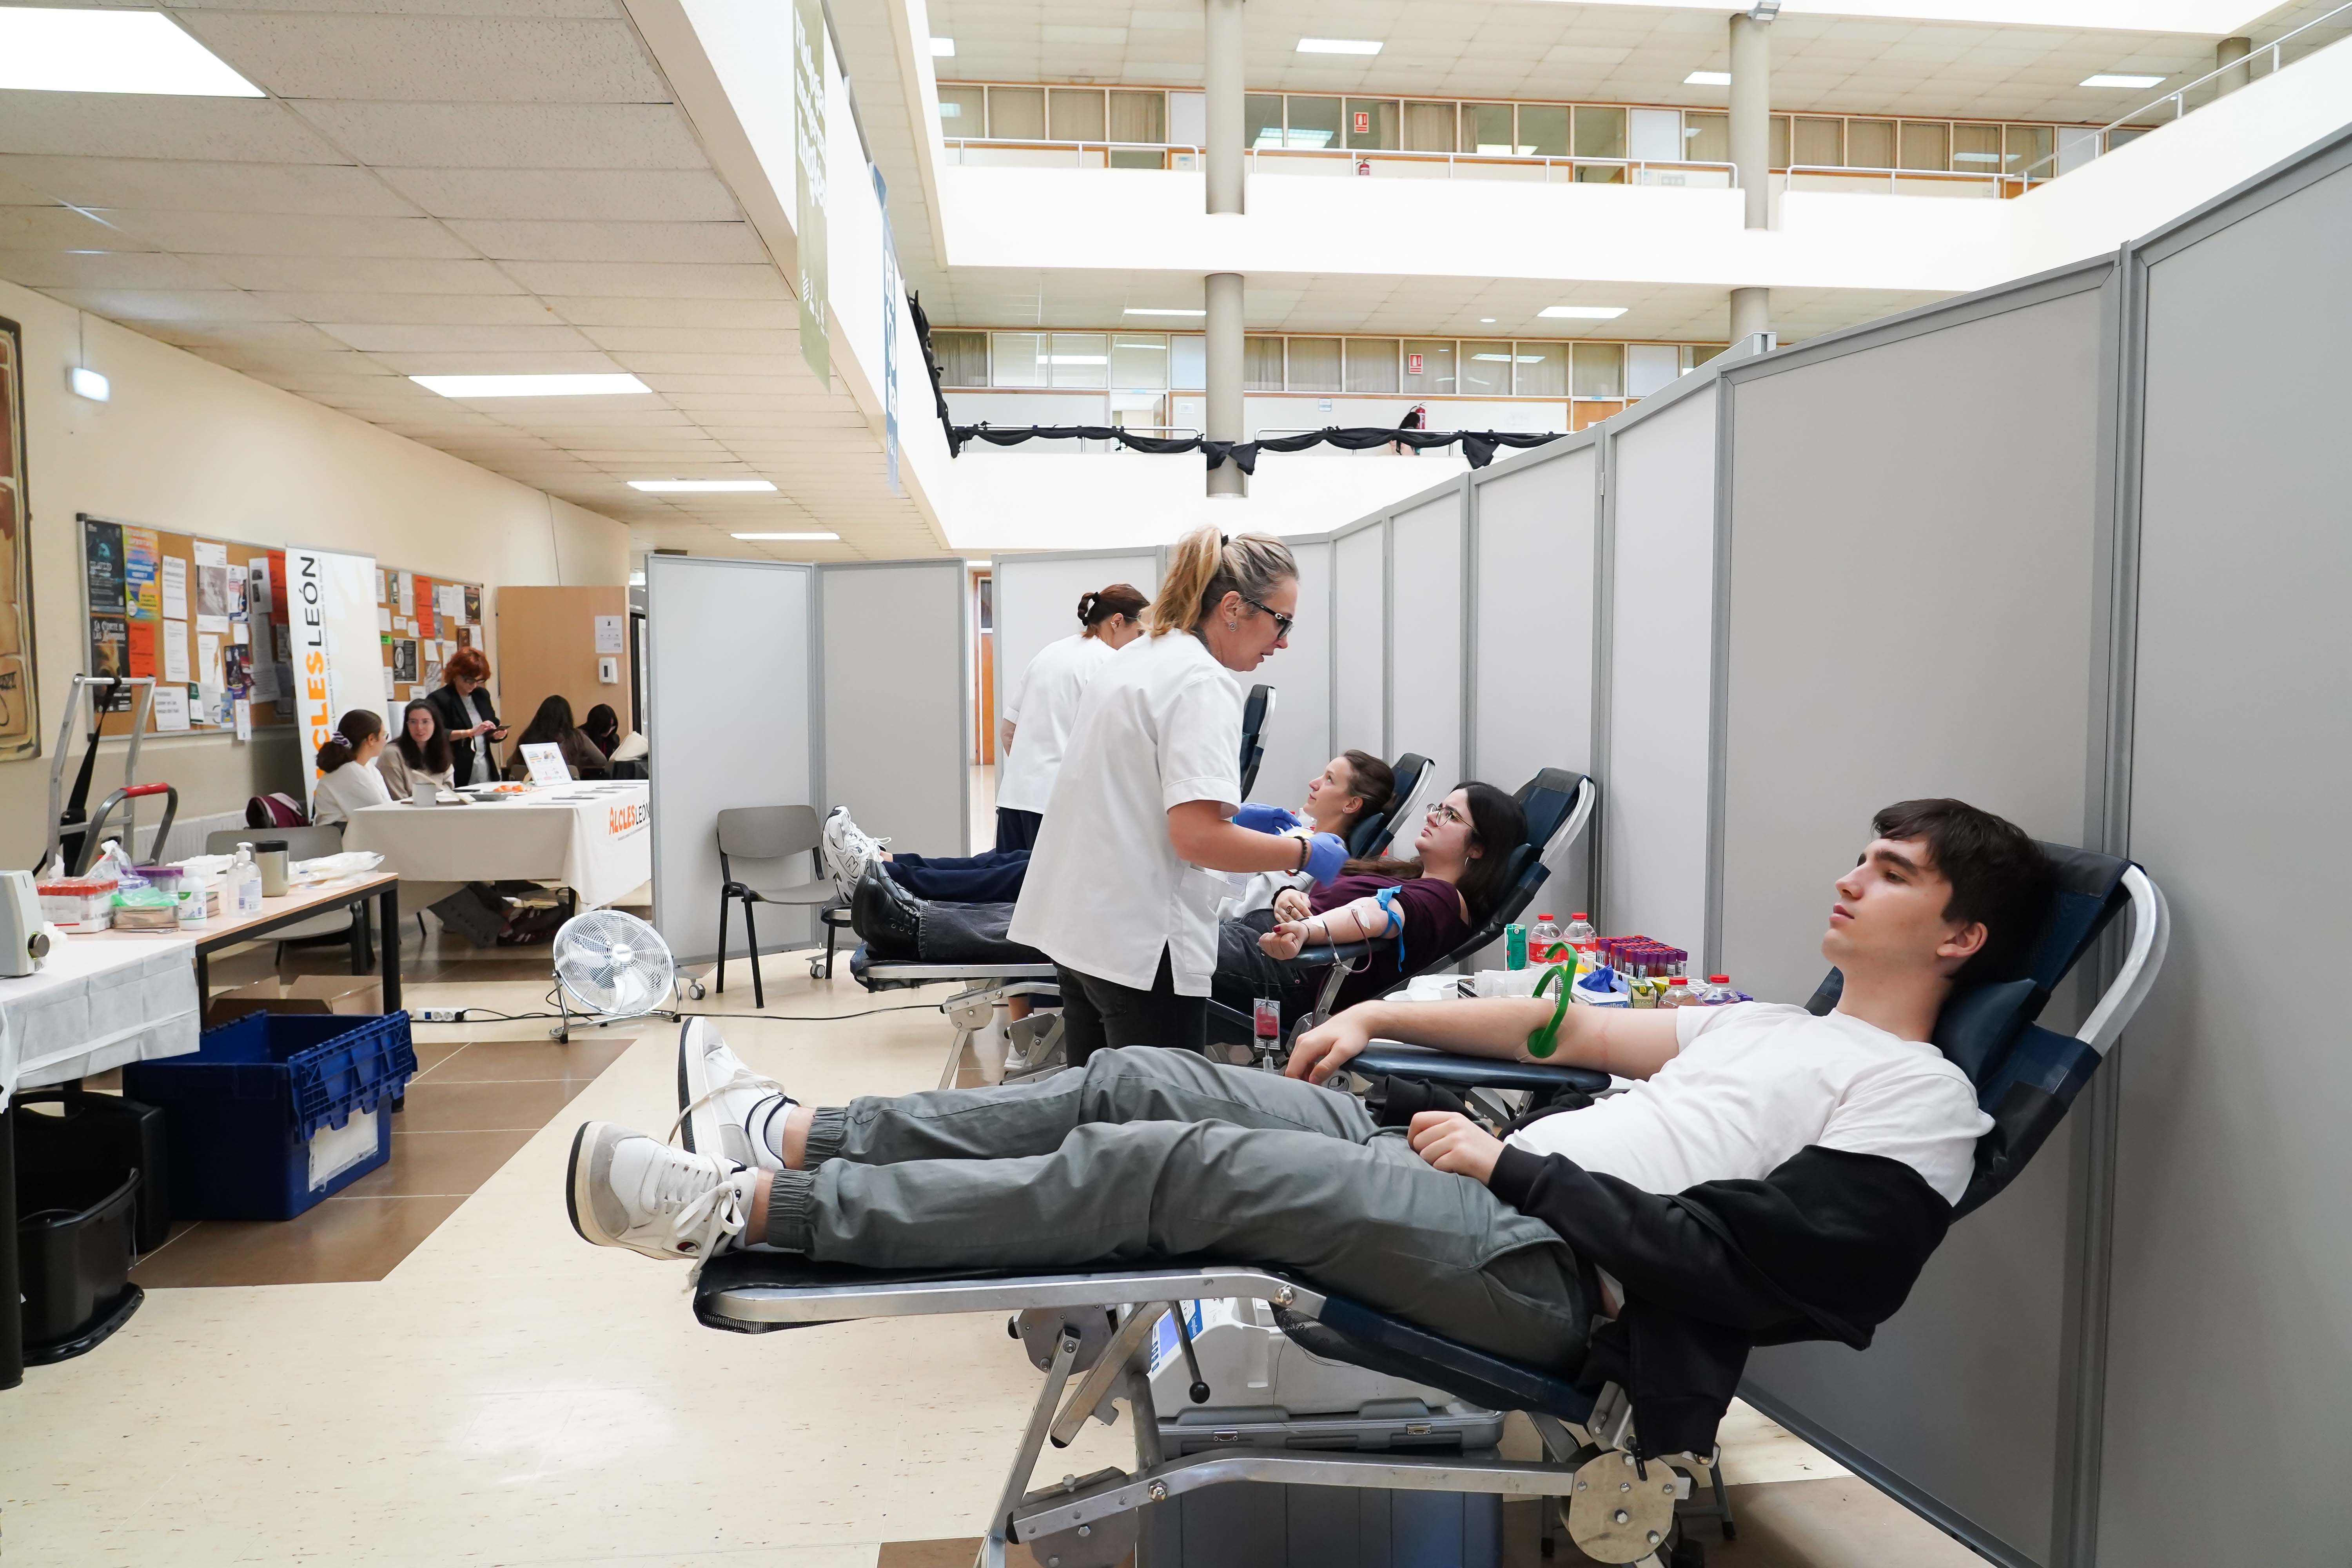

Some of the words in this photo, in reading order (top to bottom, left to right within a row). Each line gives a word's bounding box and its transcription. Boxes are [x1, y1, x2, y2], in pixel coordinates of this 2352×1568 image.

[797, 105, 827, 218] Inglés
[299, 557, 330, 796] CLESLEÓN
[609, 800, 650, 835] ALCLESLEÓN
